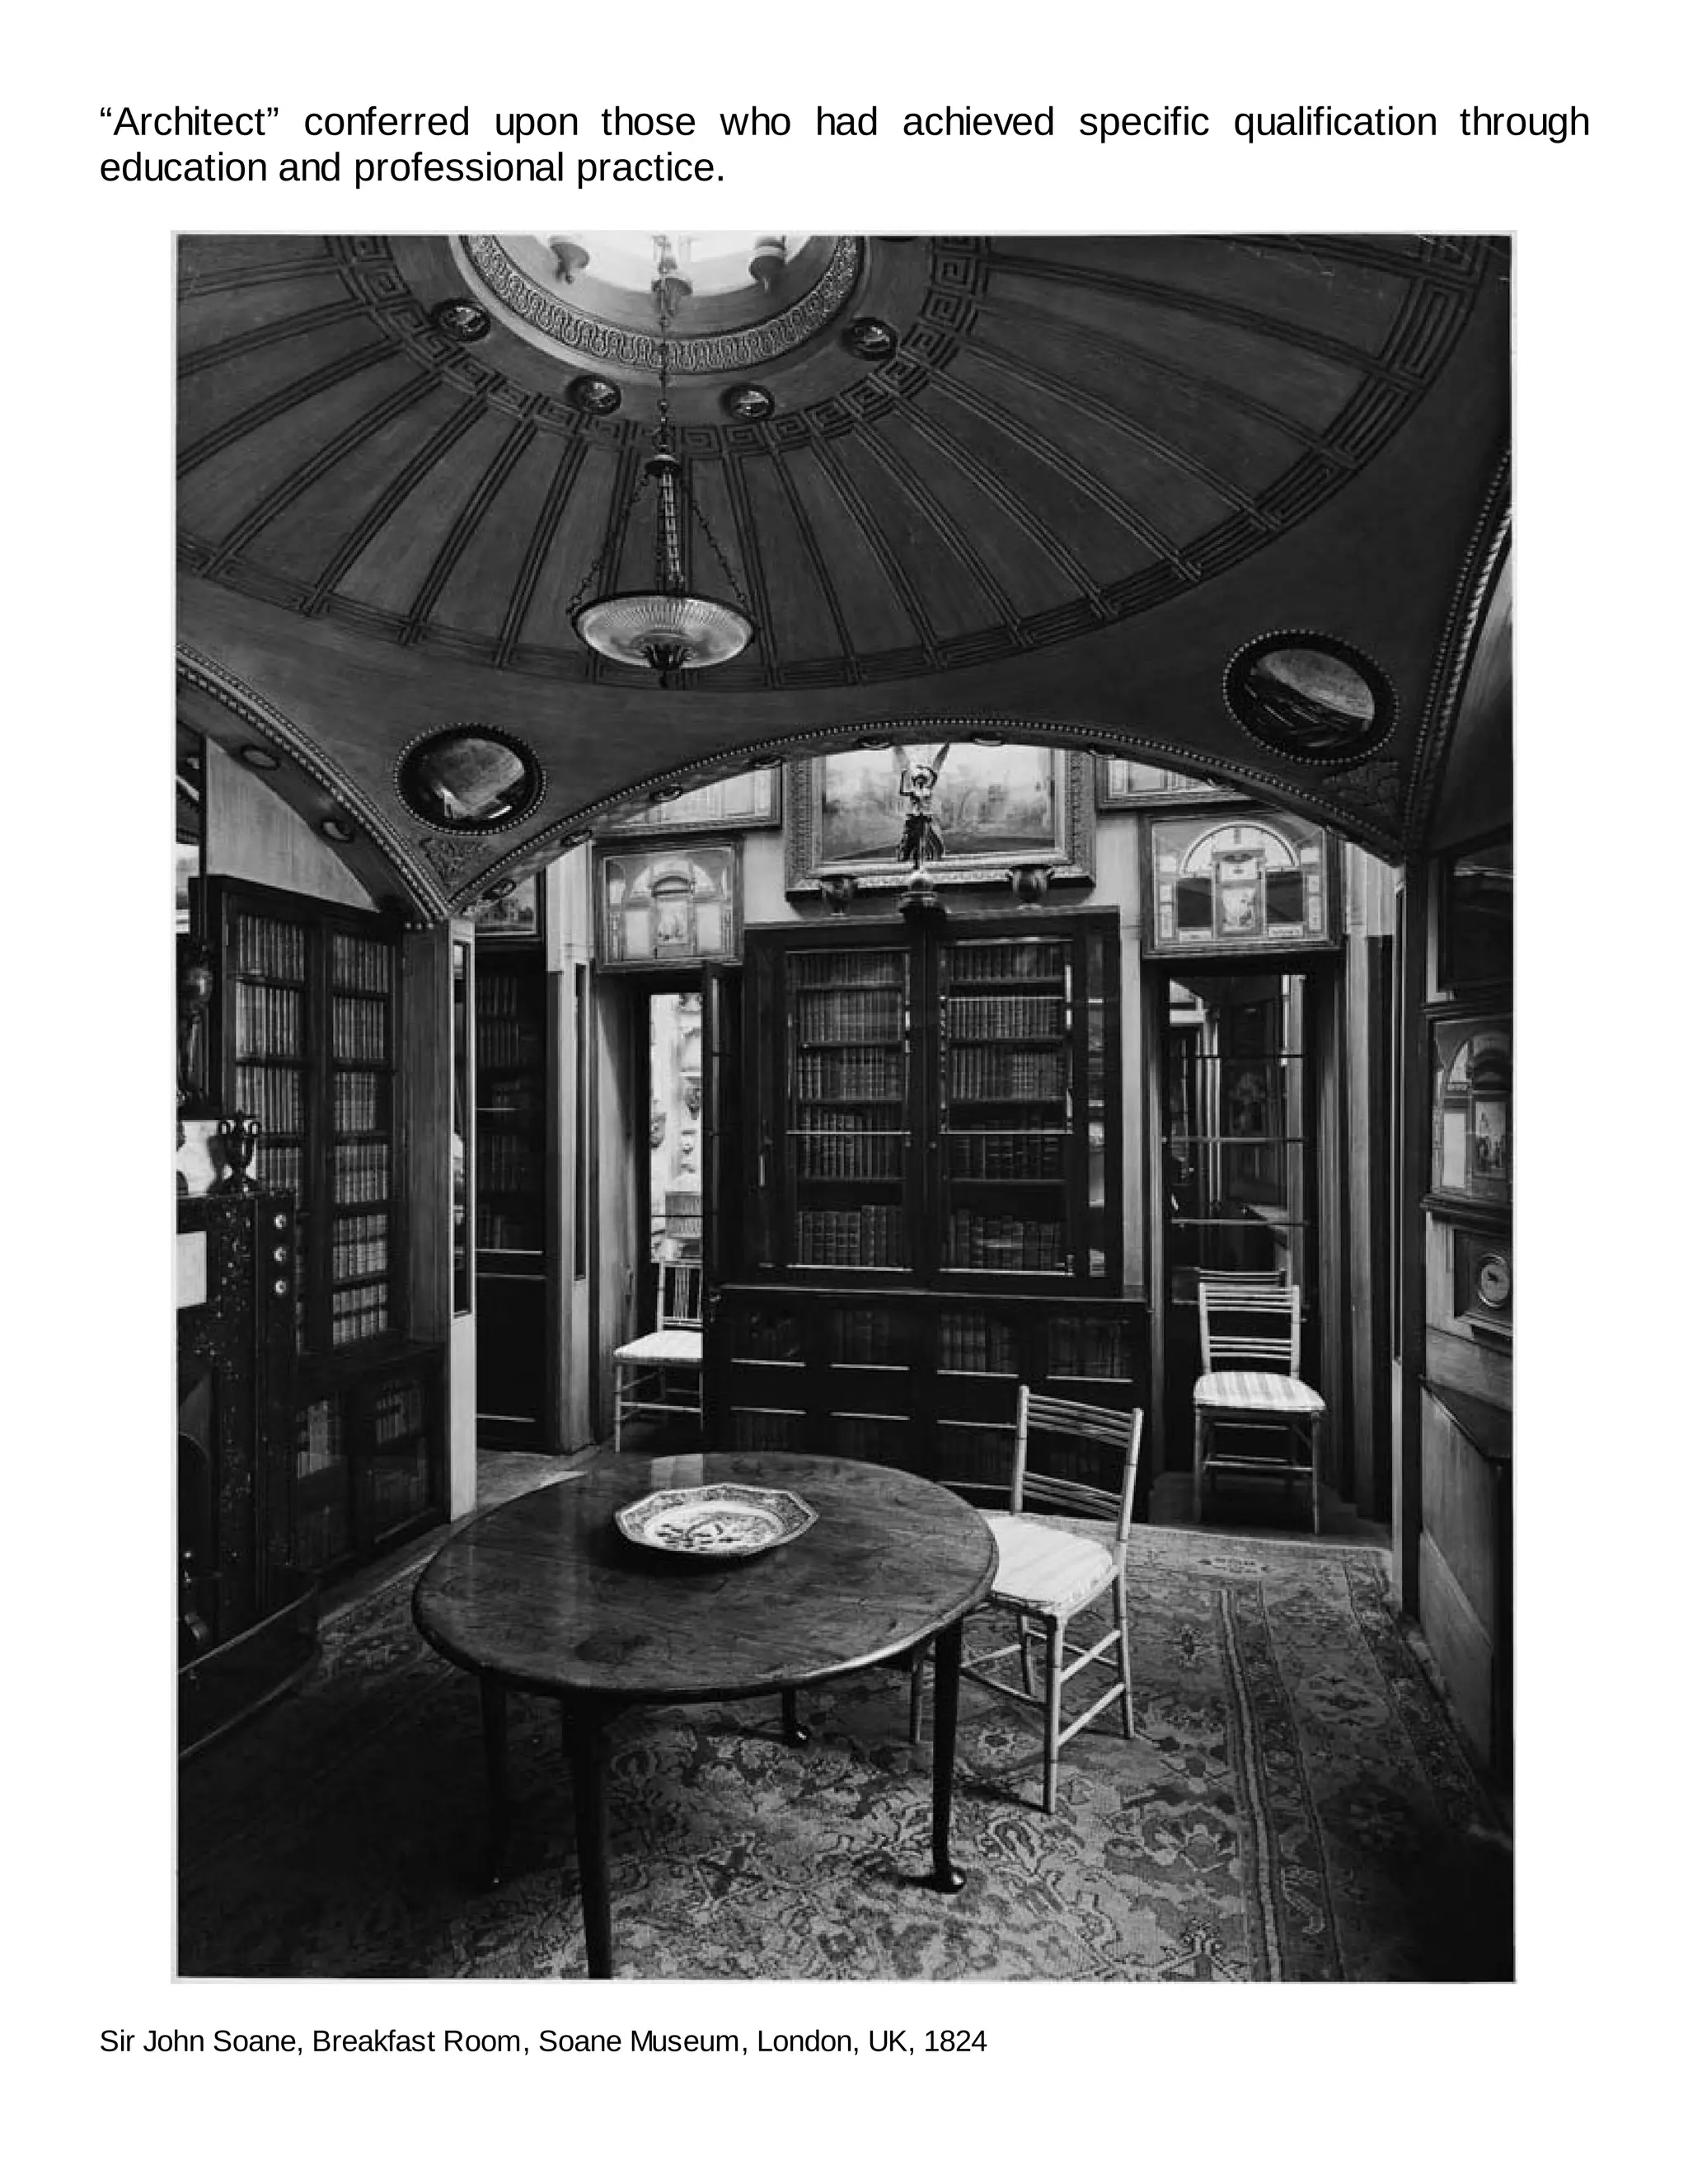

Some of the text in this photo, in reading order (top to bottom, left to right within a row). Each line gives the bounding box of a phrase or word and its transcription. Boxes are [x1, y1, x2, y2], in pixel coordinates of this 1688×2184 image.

[101, 106, 1588, 143] “Architect” conferred upon those who had achieved specific qualification through
[101, 152, 723, 189] education and professional practice.
